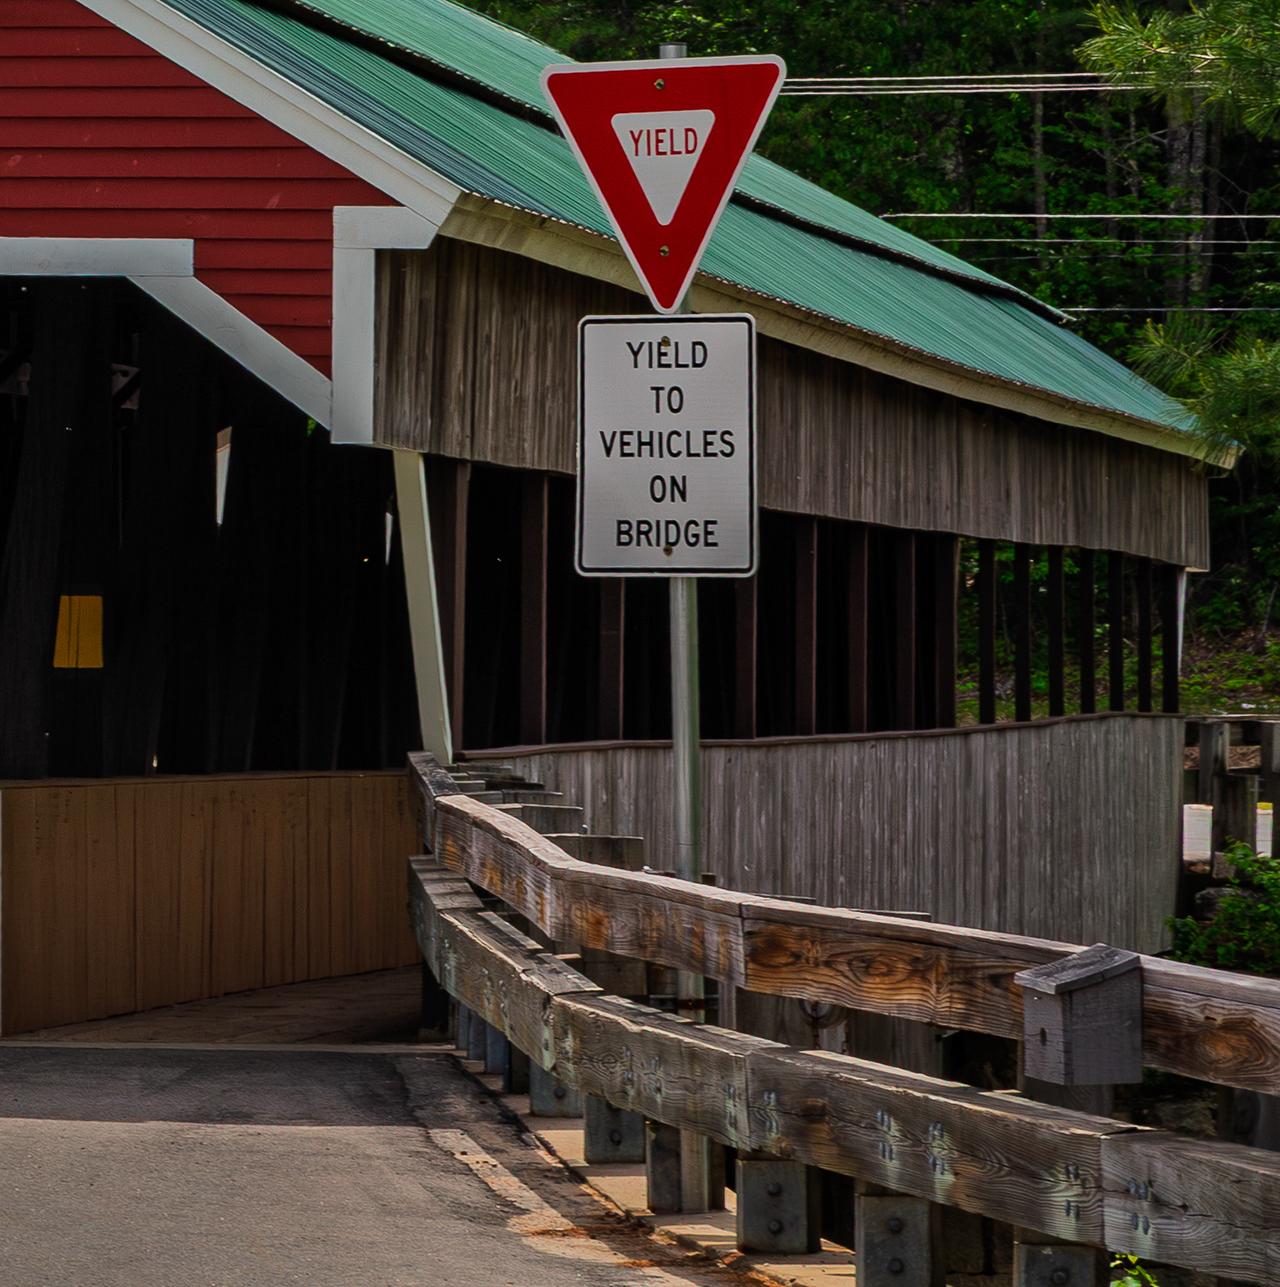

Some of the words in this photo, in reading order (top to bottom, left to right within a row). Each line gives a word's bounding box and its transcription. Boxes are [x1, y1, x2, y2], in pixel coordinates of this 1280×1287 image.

[629, 127, 699, 157] YIELD
[626, 341, 708, 369] YIELD
[650, 386, 684, 413] TO
[599, 430, 736, 458] VEHICLES
[649, 475, 687, 503] ON
[616, 519, 720, 548] BRIDGE
